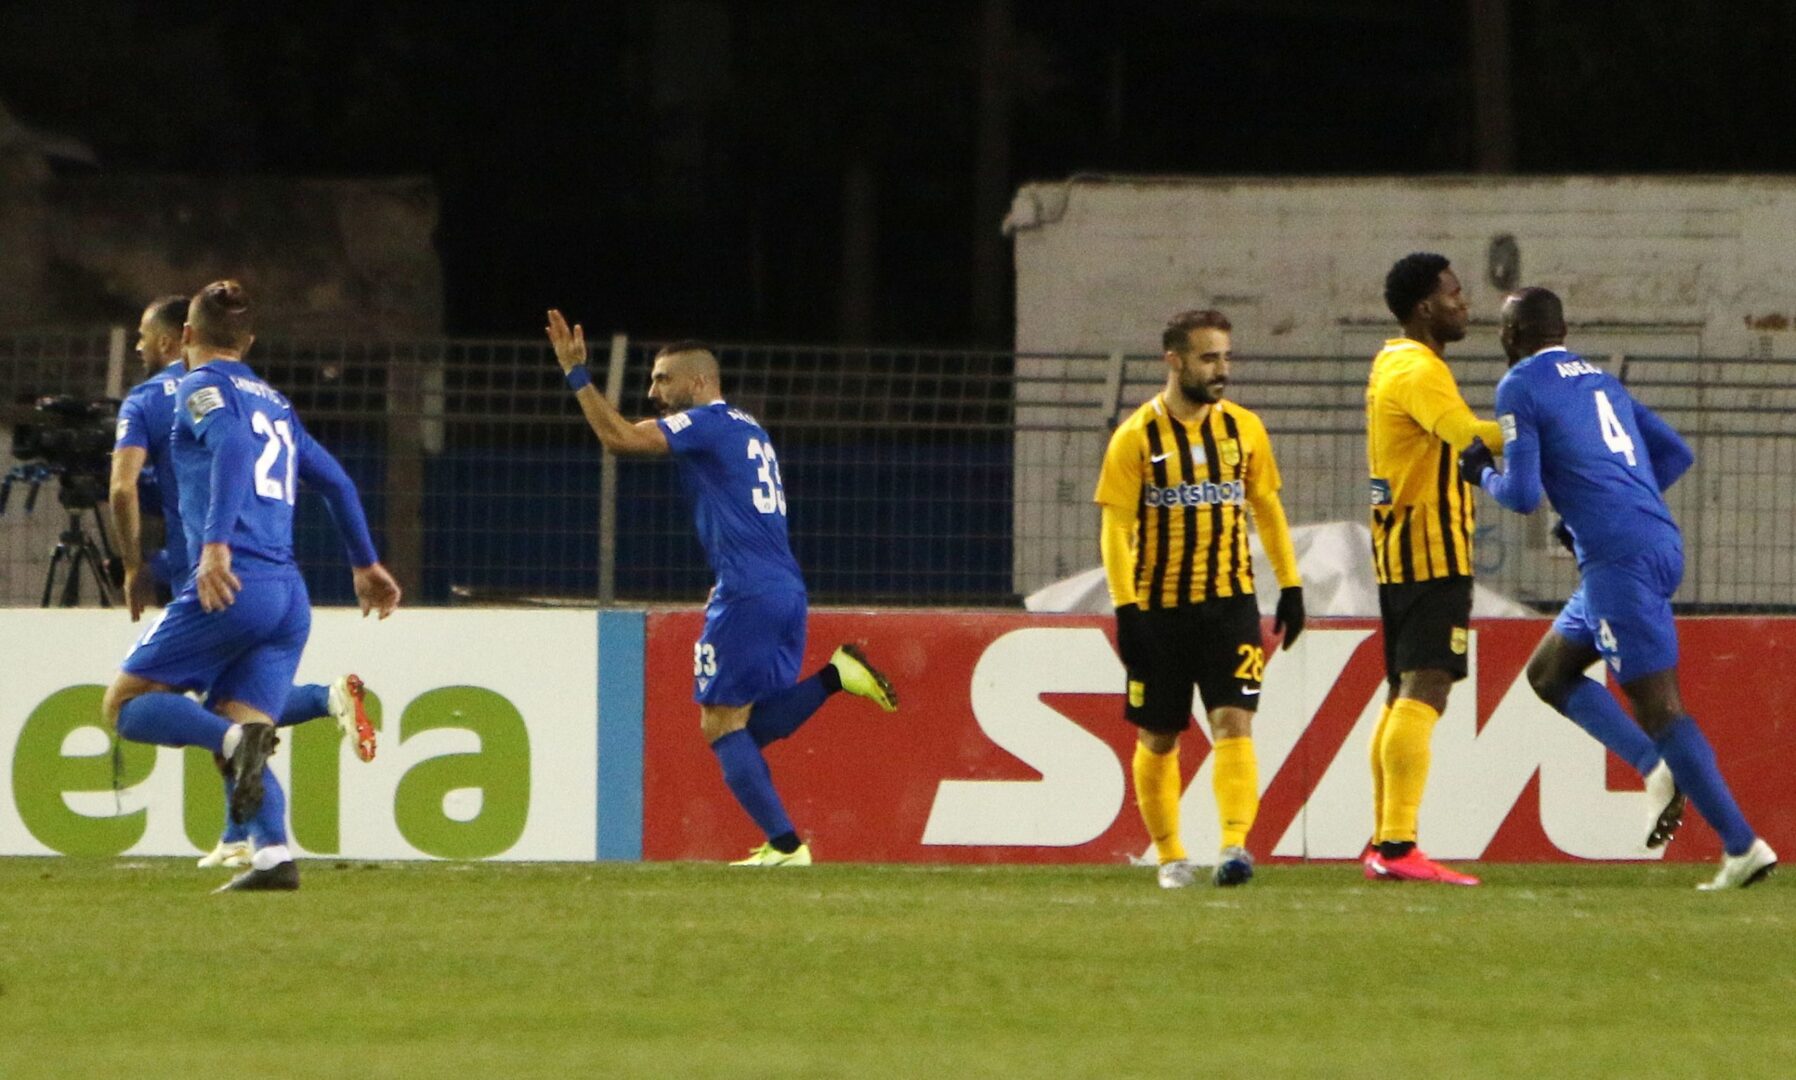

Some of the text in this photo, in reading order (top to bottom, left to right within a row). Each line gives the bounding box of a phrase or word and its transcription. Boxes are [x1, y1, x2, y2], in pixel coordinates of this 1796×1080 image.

[1595, 389, 1637, 467] 4
[251, 410, 296, 507] 21
[1234, 644, 1264, 683] 28
[1599, 618, 1618, 652] 4
